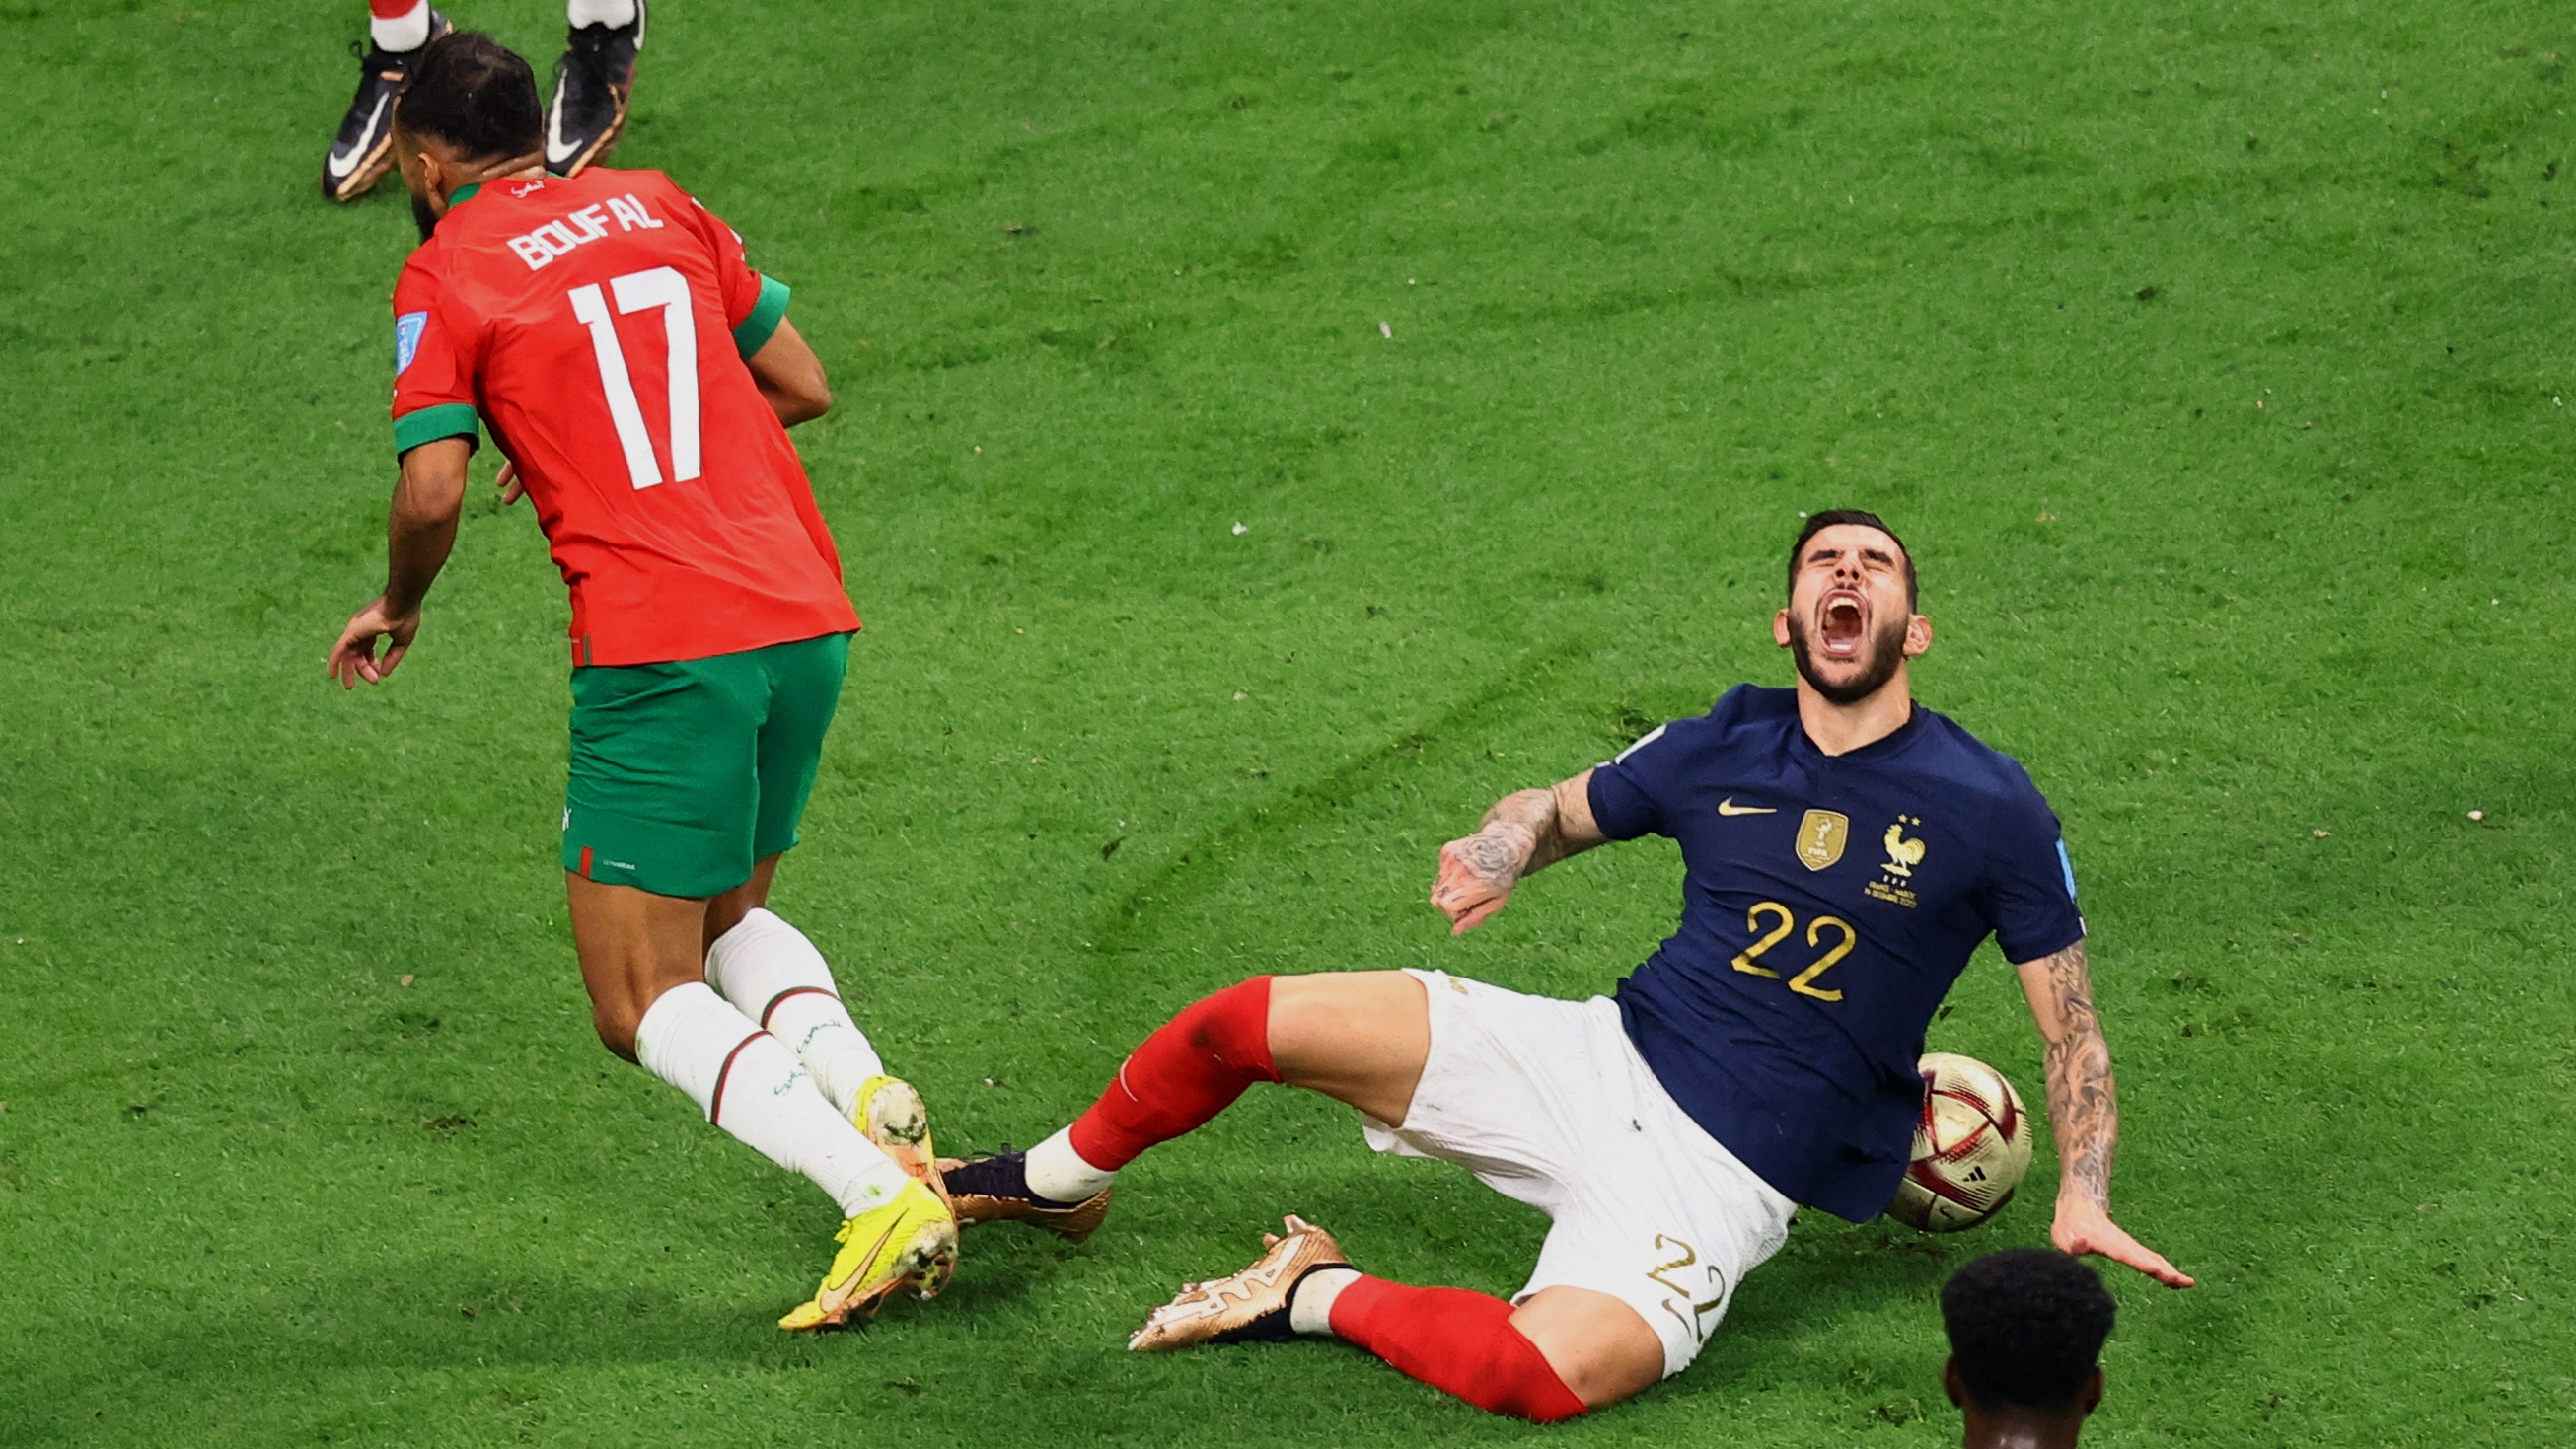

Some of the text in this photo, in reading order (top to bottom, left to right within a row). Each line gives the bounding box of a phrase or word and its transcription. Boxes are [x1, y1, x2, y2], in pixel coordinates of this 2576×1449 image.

[506, 194, 664, 271] BOUFAL
[567, 265, 701, 490] 17
[1731, 902, 1857, 1002] 22
[1646, 1233, 1726, 1344] 22
